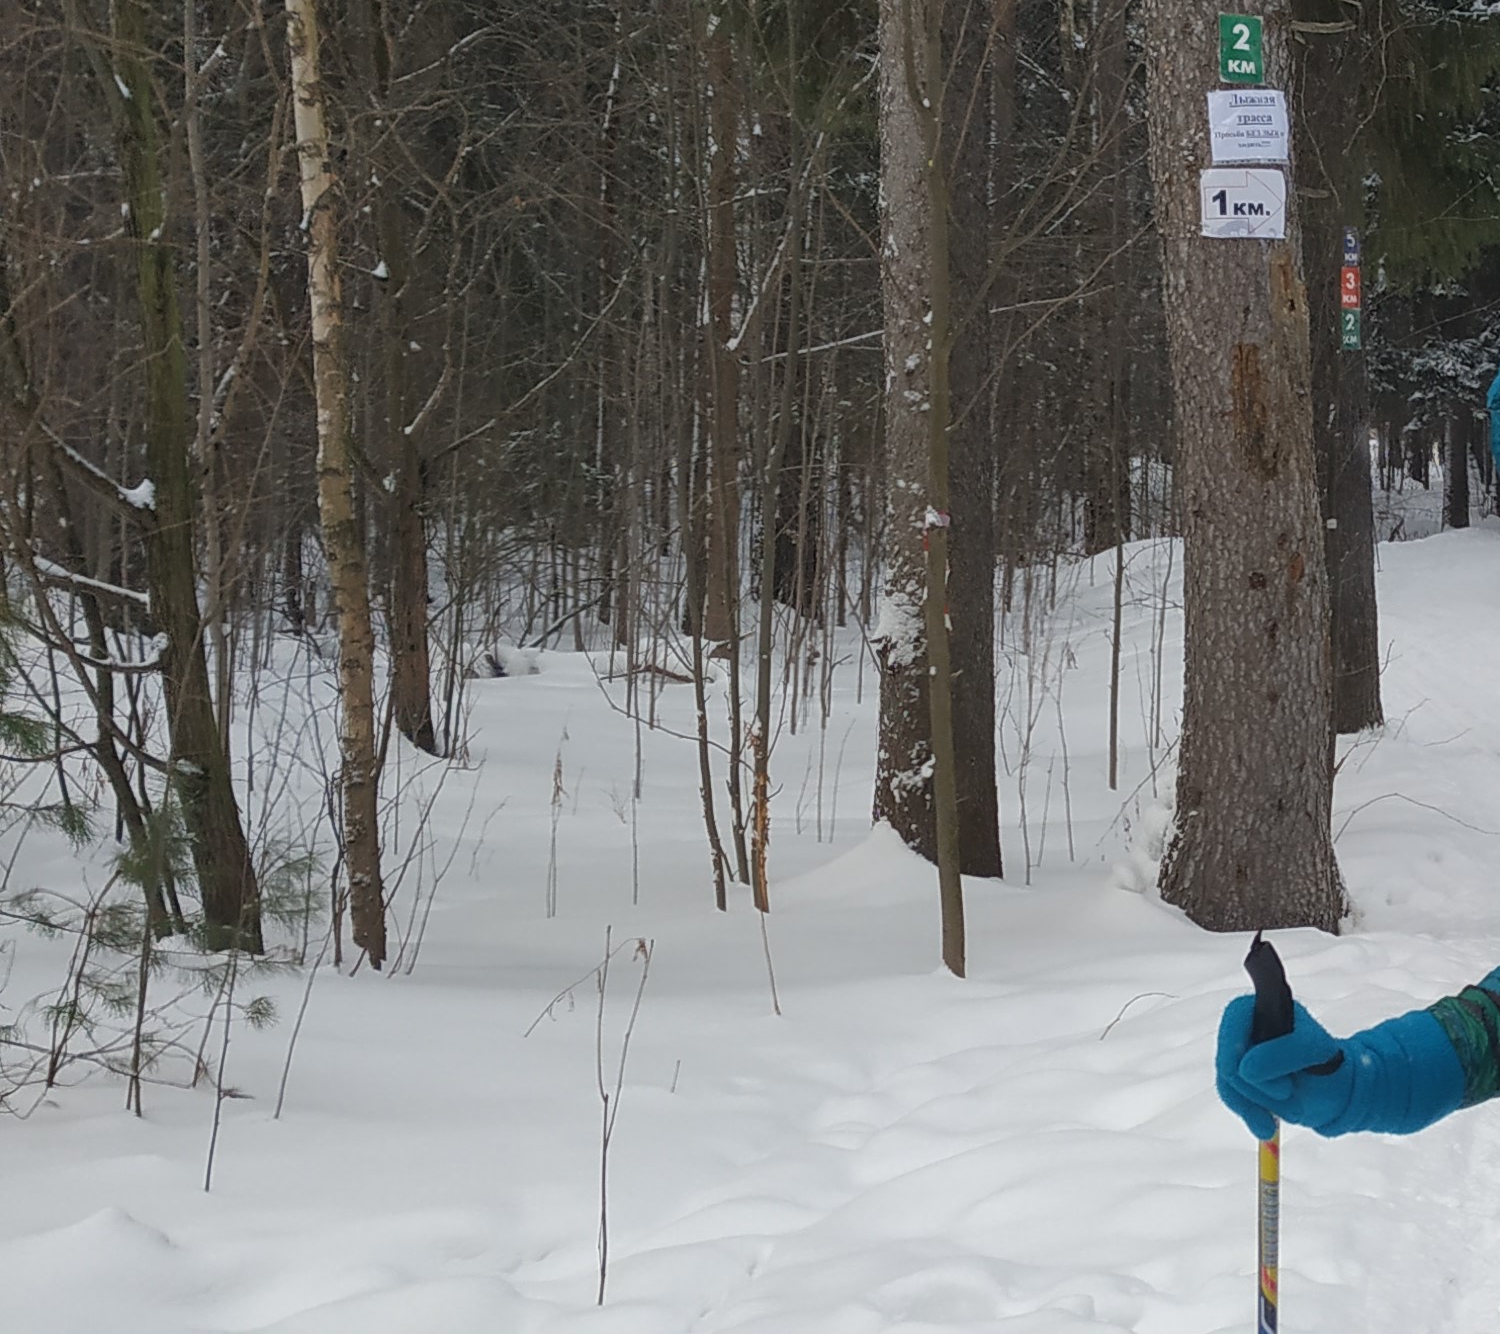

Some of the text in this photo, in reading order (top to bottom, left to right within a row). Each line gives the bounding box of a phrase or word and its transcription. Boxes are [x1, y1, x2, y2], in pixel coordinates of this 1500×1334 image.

[1232, 23, 1250, 51] 2
[1229, 94, 1276, 106] Лыжная
[1236, 114, 1273, 124] трасса
[1212, 190, 1227, 215] 1
[1346, 233, 1356, 247] 5
[1345, 272, 1356, 289] 3
[1345, 313, 1355, 330] 2
